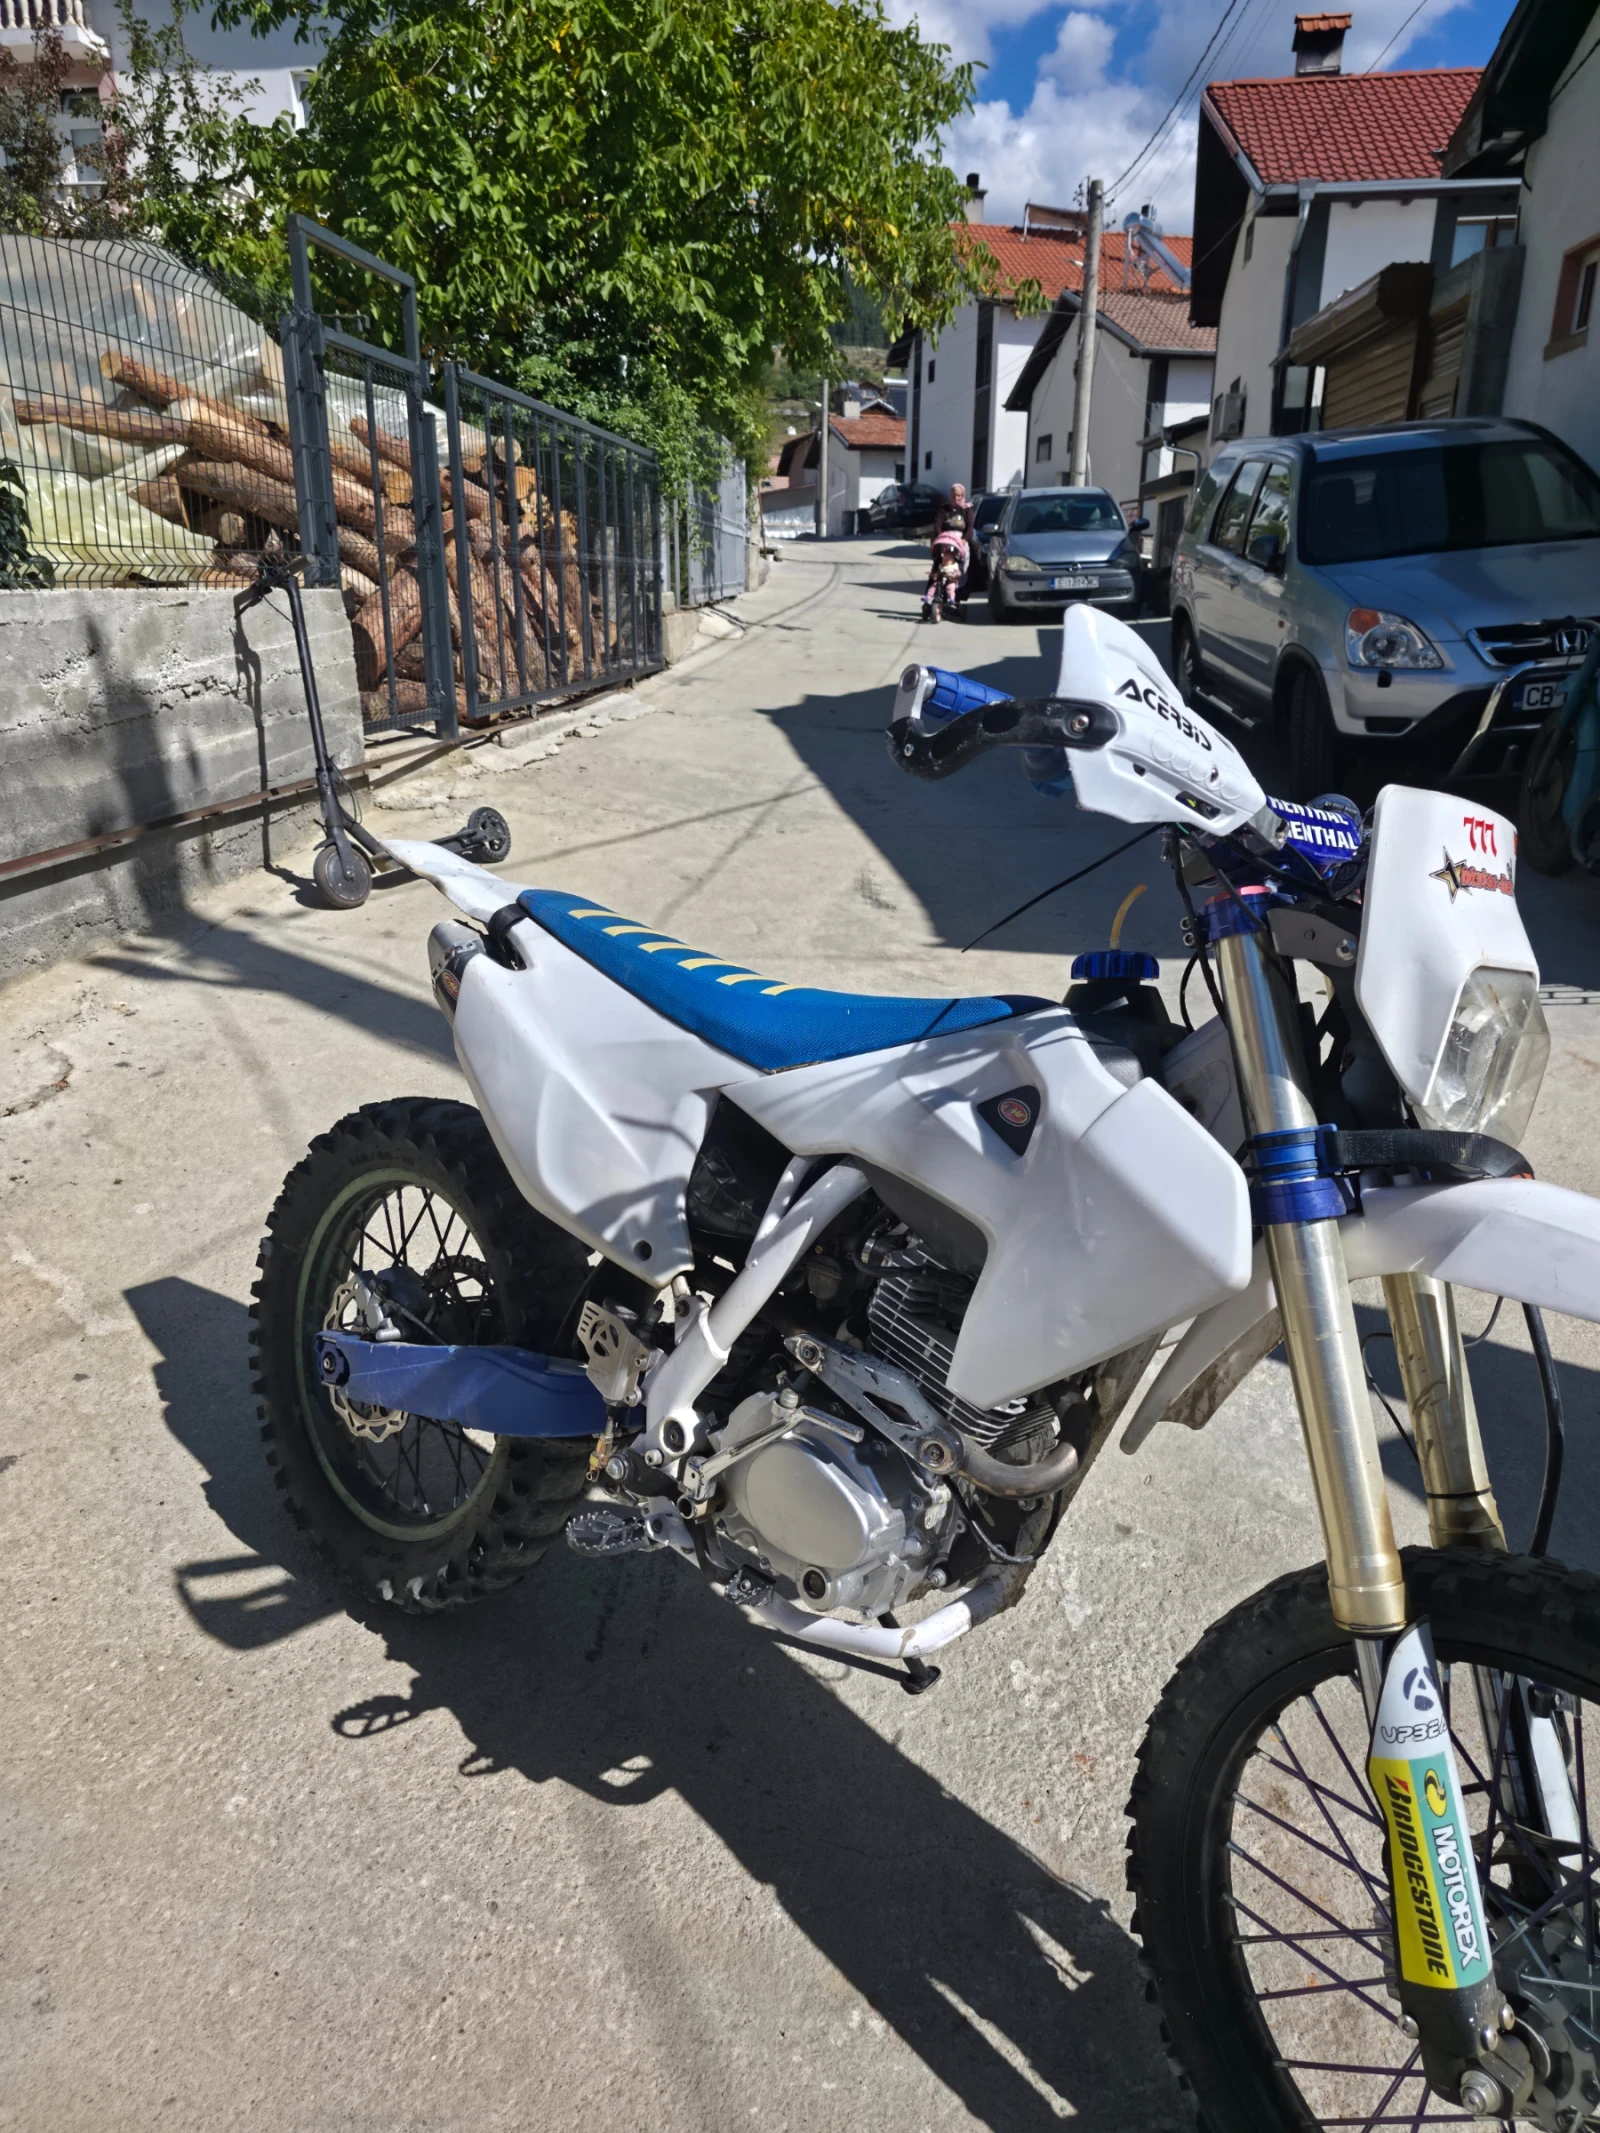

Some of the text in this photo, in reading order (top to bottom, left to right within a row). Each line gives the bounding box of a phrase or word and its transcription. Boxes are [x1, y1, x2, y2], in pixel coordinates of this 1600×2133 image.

[1463, 816, 1498, 858] 777
[1384, 1777, 1450, 1979] BRIDGESTONE
[1431, 1826, 1483, 1971] MOTOREX
